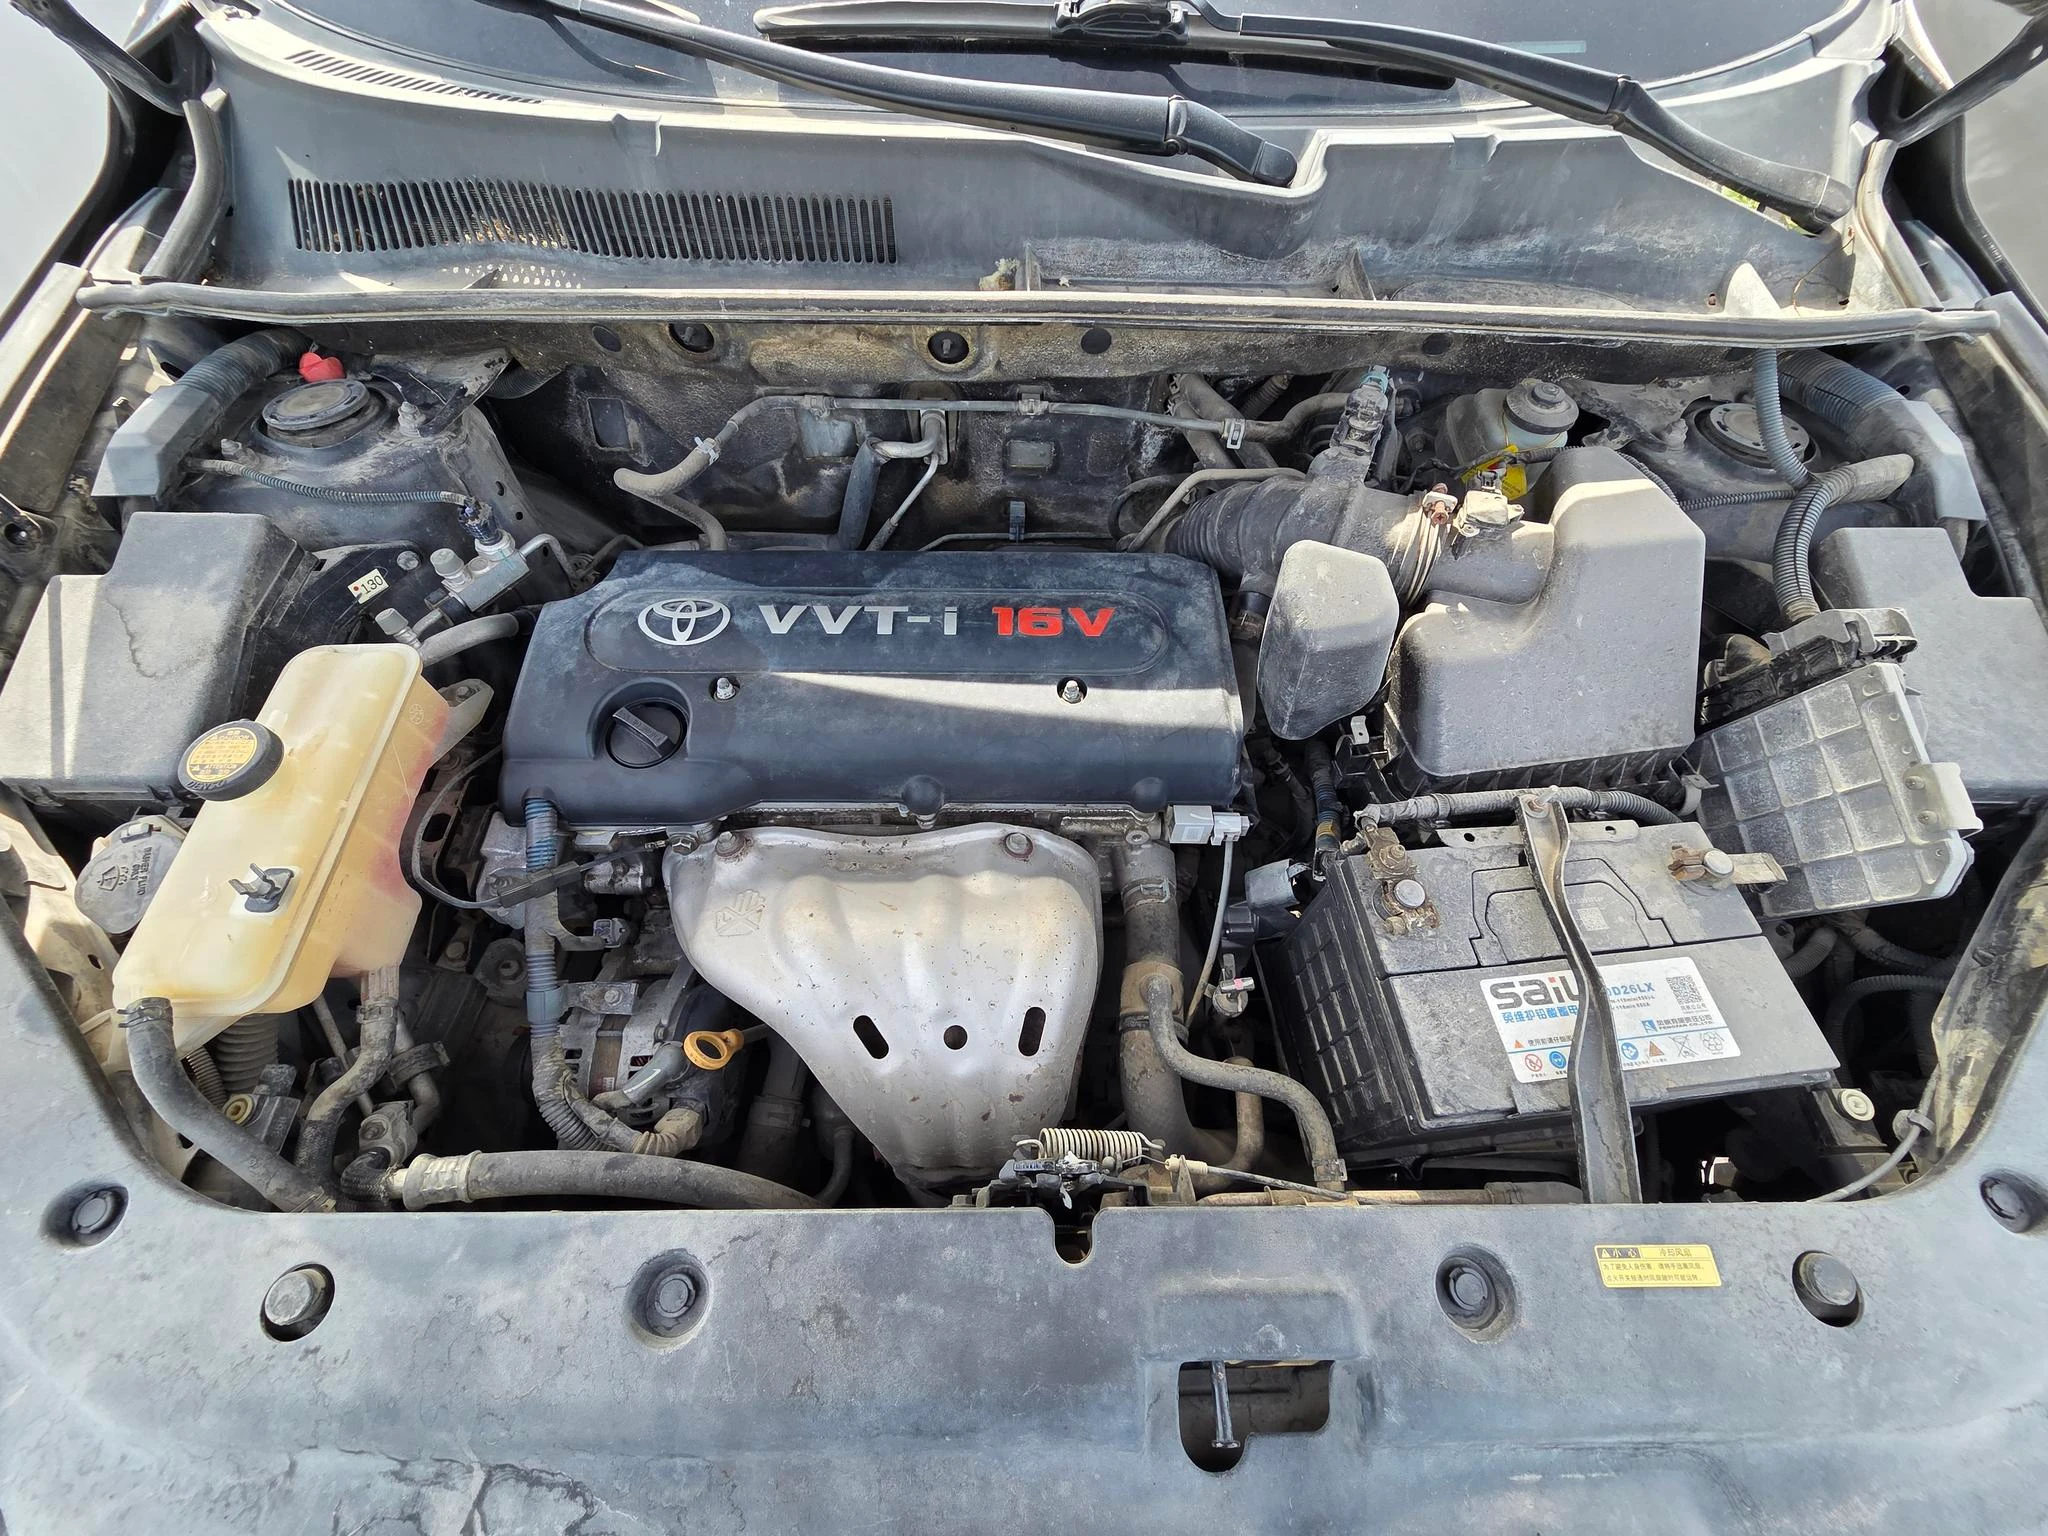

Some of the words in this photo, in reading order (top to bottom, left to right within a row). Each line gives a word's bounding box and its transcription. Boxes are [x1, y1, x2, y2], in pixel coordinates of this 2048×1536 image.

[361, 575, 384, 595] 130
[758, 604, 958, 636] VVT-i
[991, 606, 1116, 637] 16V
